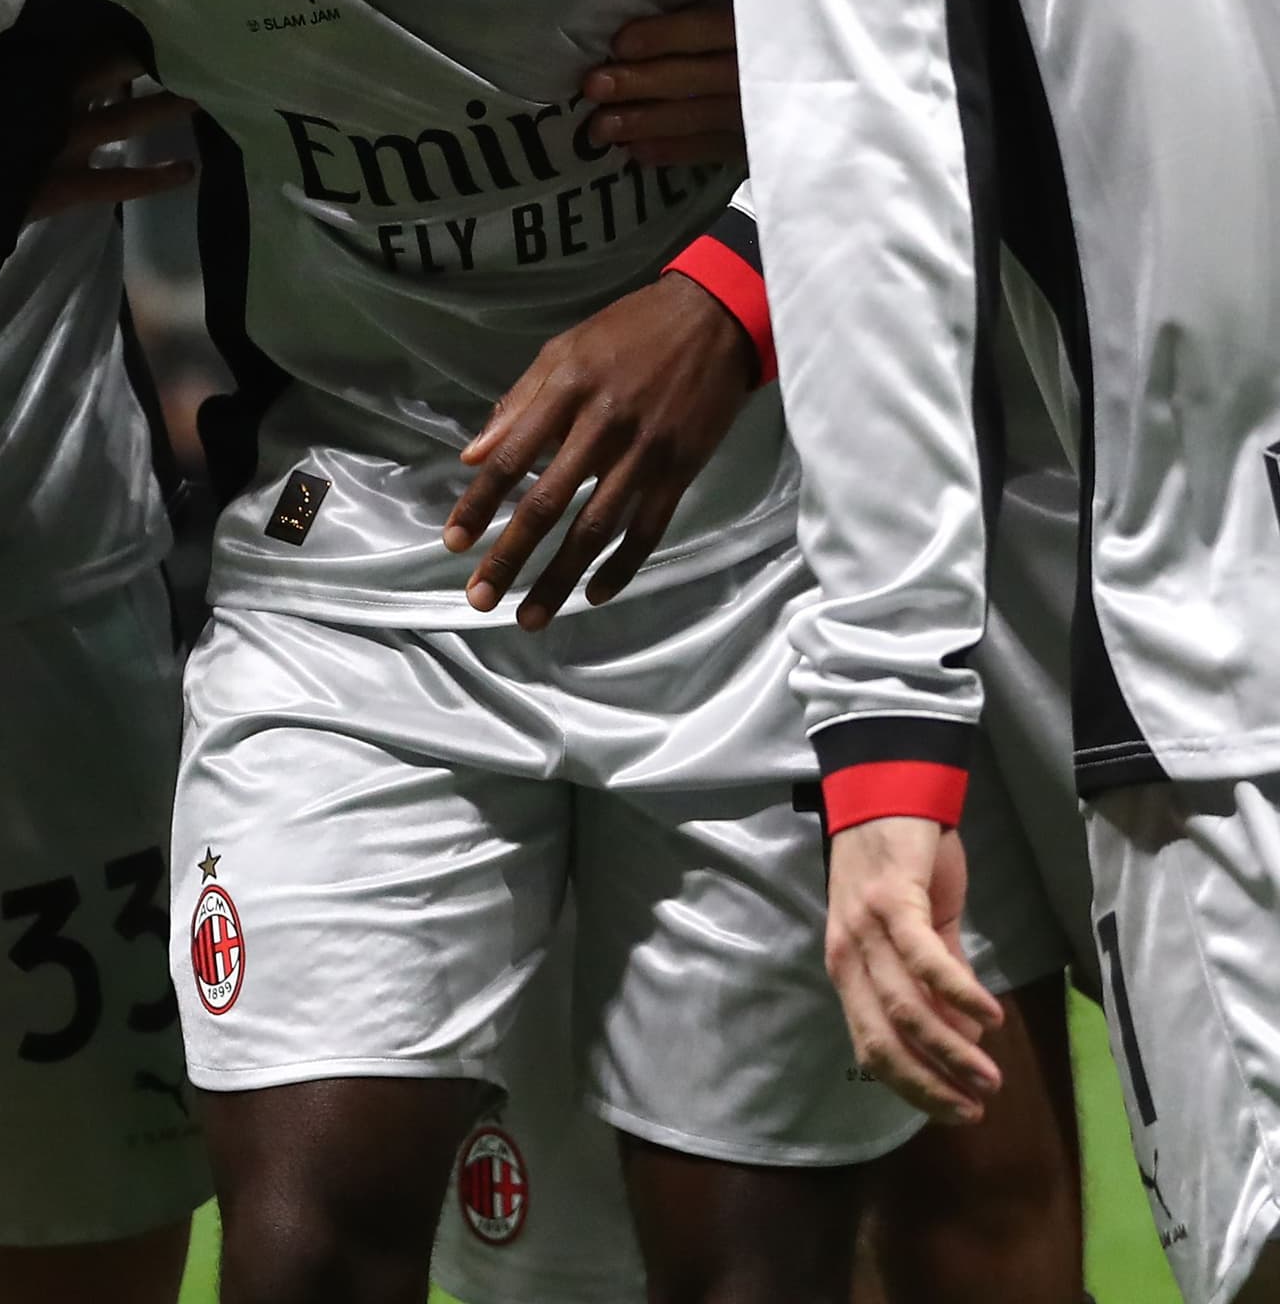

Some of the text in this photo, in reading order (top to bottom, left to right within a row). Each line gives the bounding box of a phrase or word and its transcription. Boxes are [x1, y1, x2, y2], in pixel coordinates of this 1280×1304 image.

[263, 8, 341, 31] SLAM JAM
[376, 217, 477, 274] FLY
[199, 896, 226, 920] ACM
[1, 846, 180, 1063] 33
[207, 981, 233, 1000] 1899
